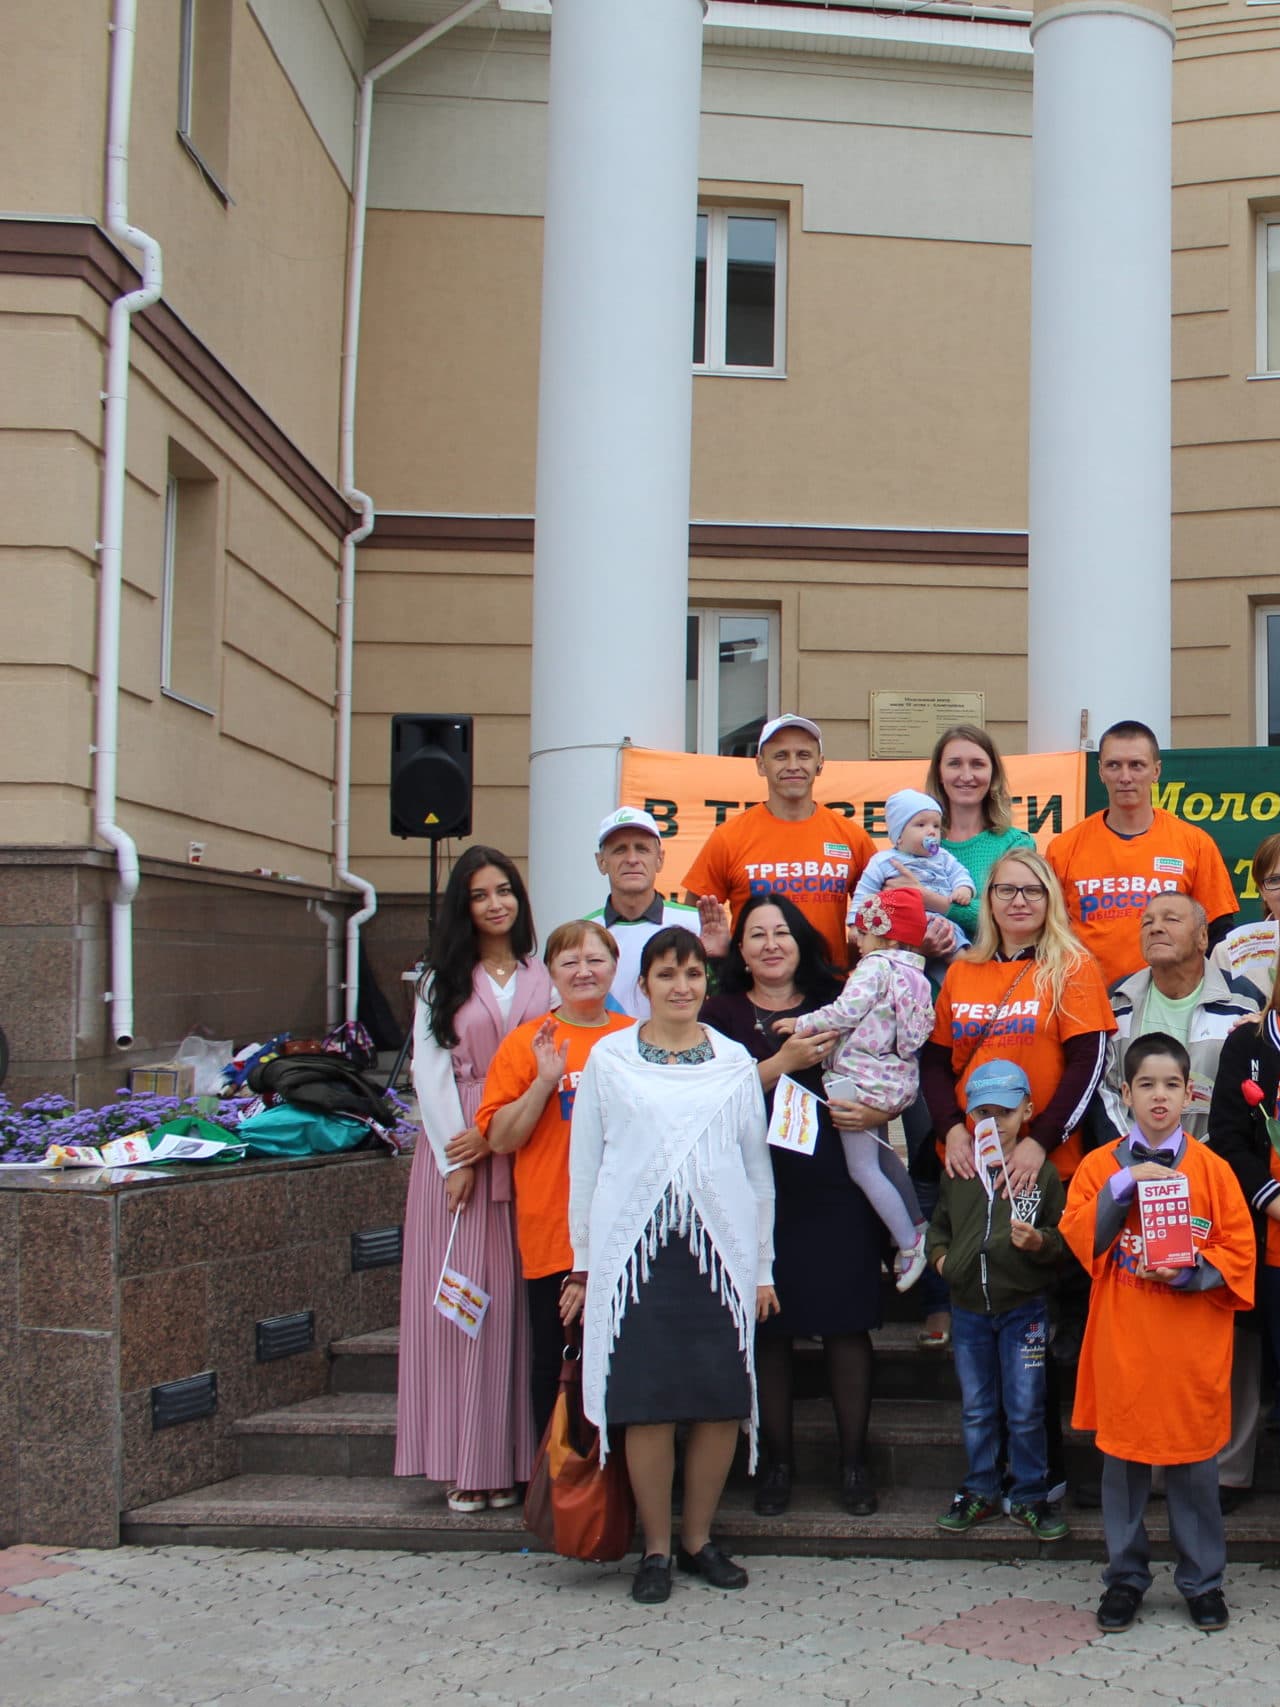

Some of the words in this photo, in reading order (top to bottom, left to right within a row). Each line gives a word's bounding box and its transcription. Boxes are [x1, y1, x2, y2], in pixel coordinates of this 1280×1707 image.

[745, 861, 849, 879] ТРЕЗВАЯ
[749, 877, 847, 898] РОССИЯ
[1075, 876, 1178, 895] ТРЕЗВАЯ
[1145, 1185, 1180, 1197] STAFF
